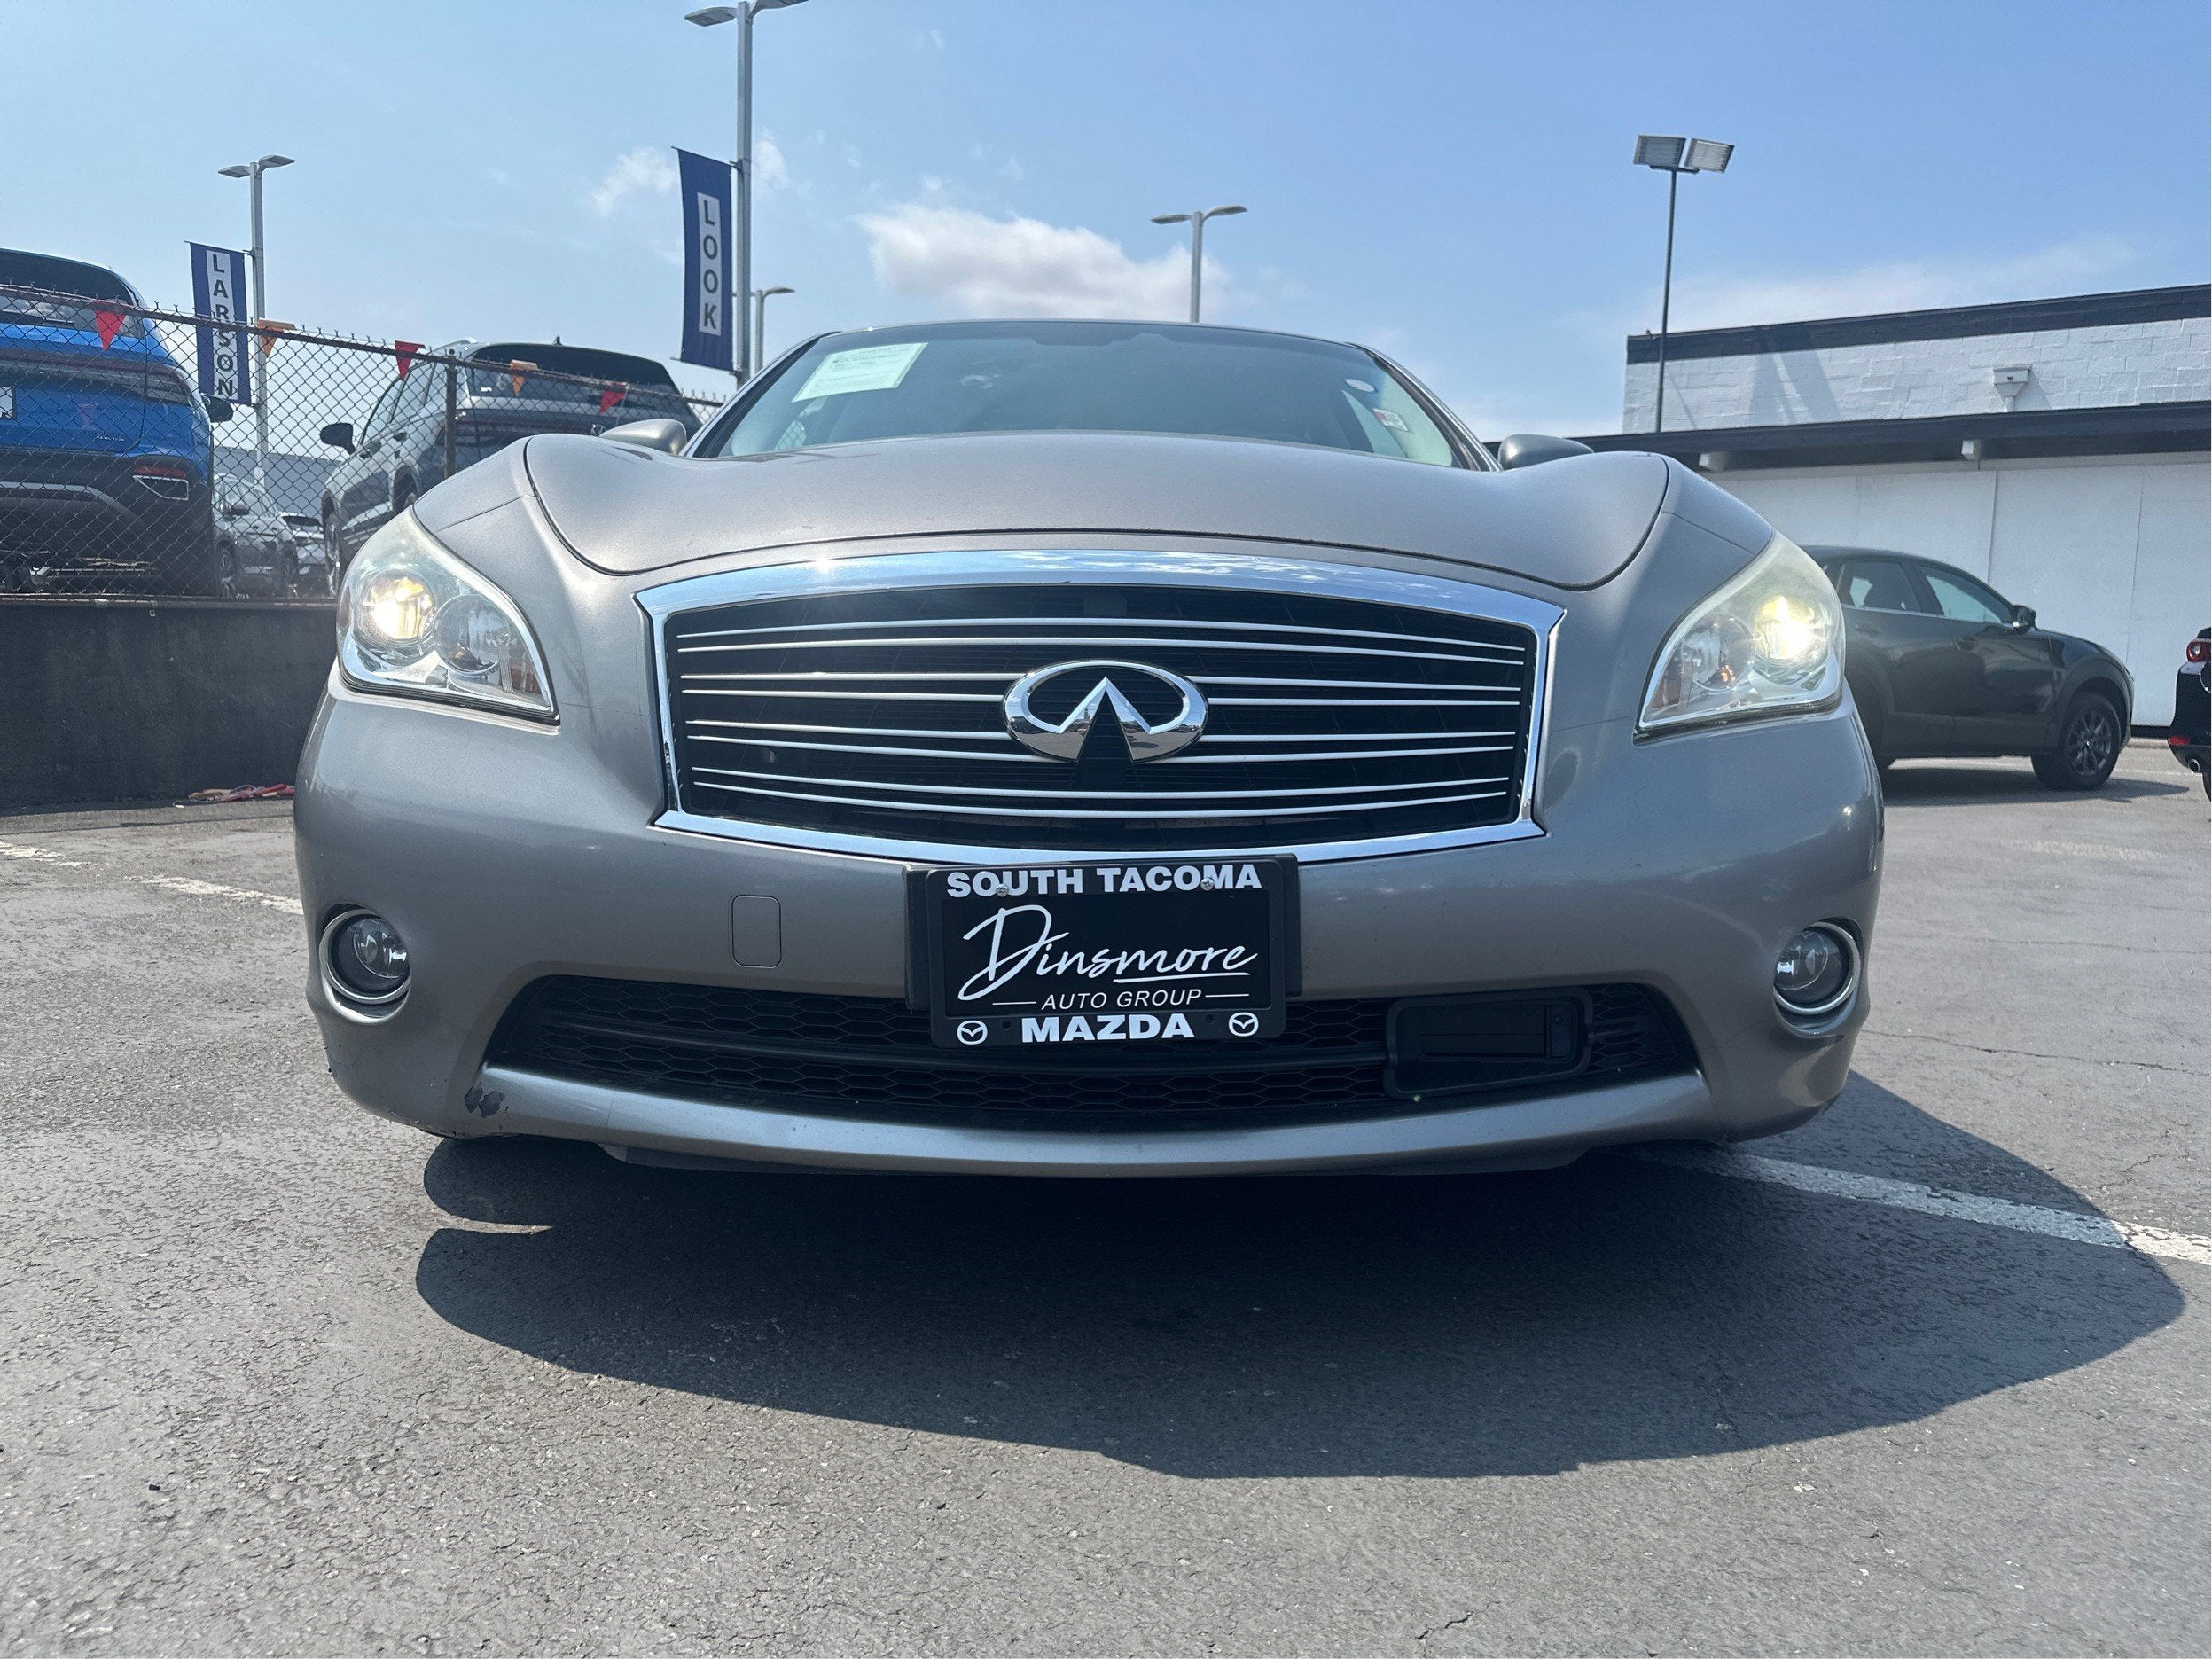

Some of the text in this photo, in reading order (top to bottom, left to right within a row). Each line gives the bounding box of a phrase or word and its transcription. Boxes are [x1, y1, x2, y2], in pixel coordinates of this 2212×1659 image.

[703, 200, 719, 330] LOOK
[213, 254, 235, 397] LARSON
[947, 864, 1262, 898] SOUTH TACOMA
[957, 904, 1258, 1001] Dinsmore
[1021, 1013, 1195, 1044] MAZDA
[1041, 988, 1202, 1010] AUTO GROUP
